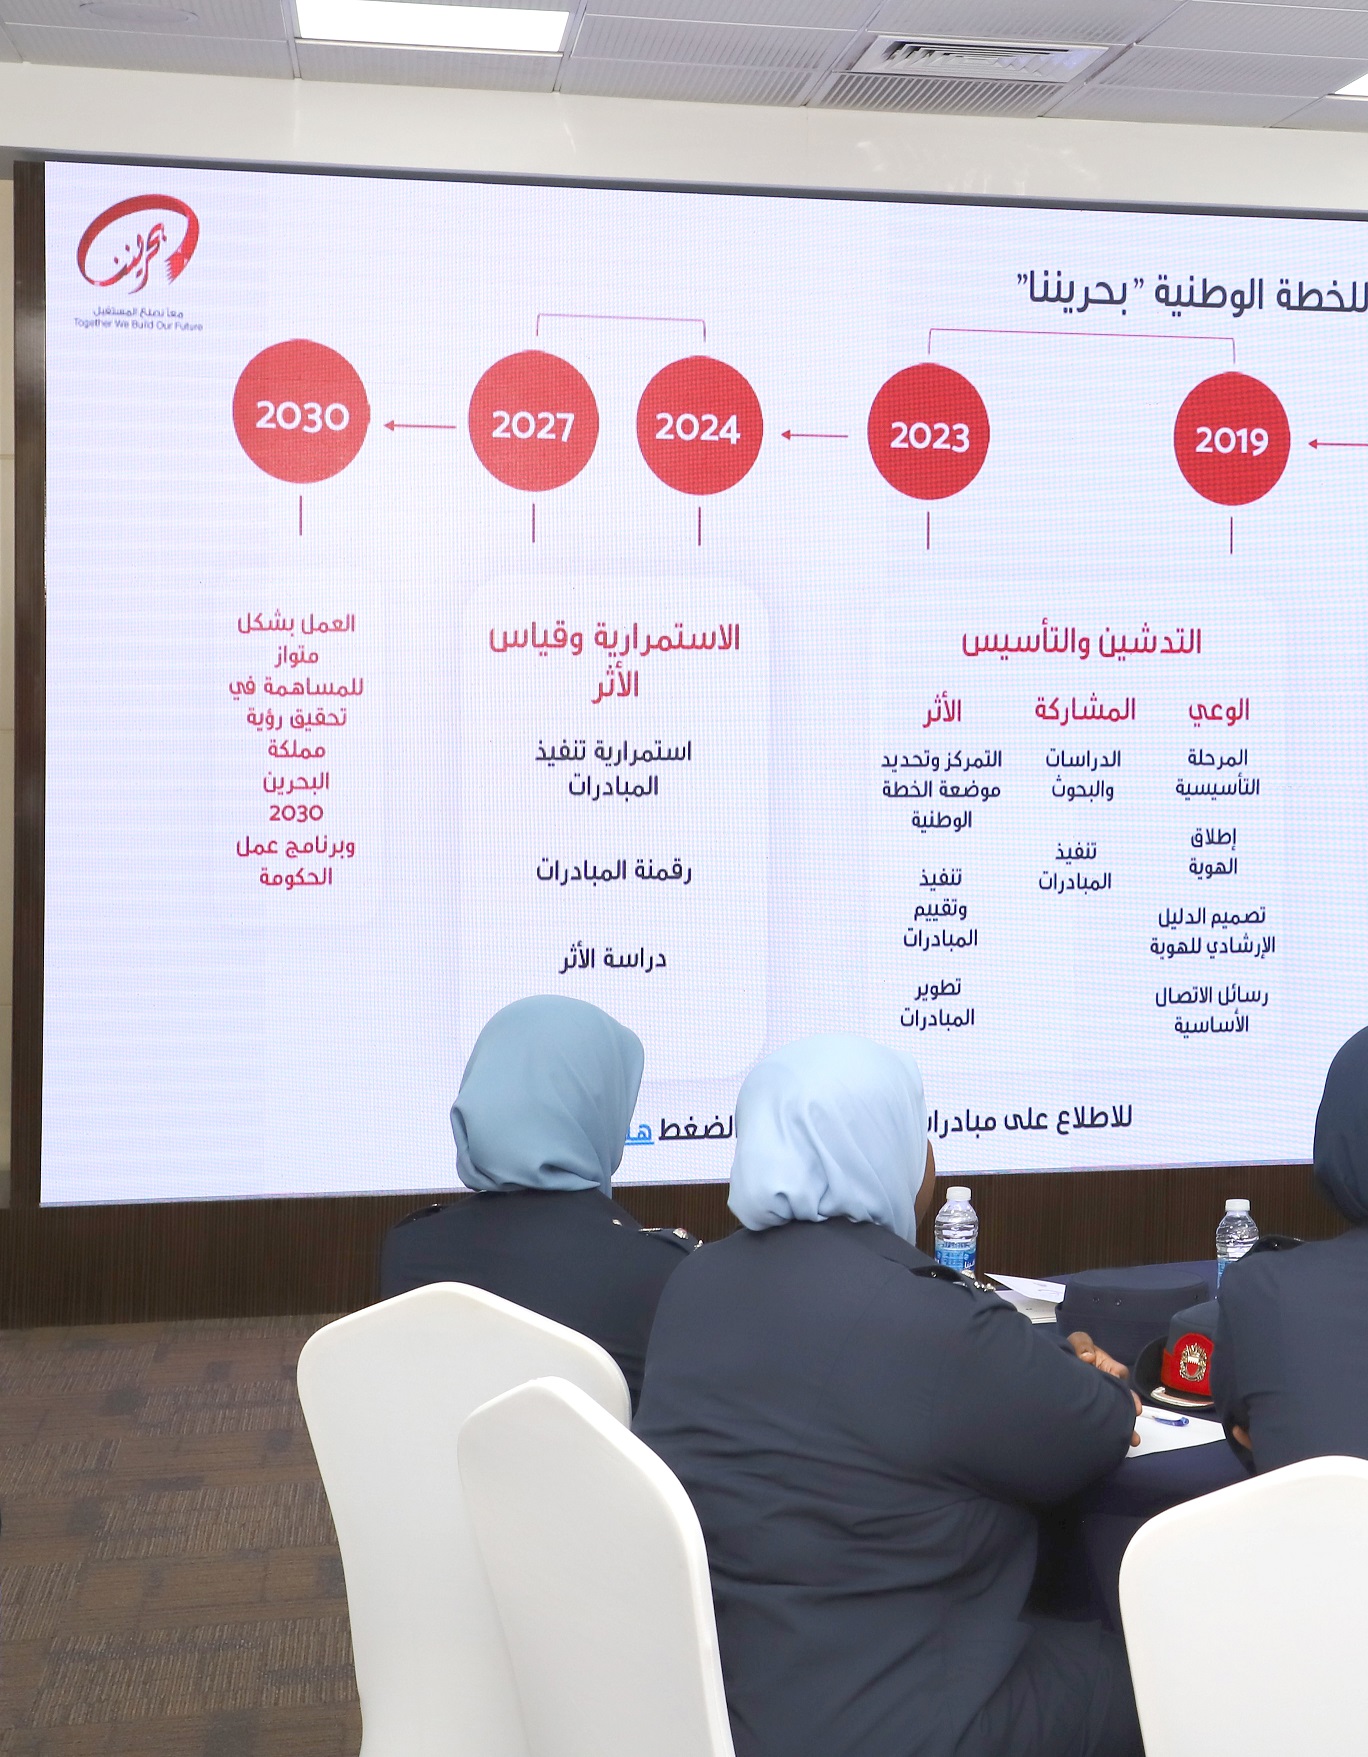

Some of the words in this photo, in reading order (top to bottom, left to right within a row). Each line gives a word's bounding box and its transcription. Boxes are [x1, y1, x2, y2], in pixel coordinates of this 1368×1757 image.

[1155, 274, 1263, 318] الوطنية
[1276, 278, 1368, 313] للخطة
[74, 317, 112, 329] Together
[132, 319, 154, 330] Build
[156, 321, 173, 330] Our
[175, 321, 203, 331] Future
[256, 401, 349, 433] 2030
[492, 411, 574, 442] 2027
[656, 413, 740, 444] 2024
[891, 422, 969, 452] 2023
[1196, 427, 1268, 456] 2019
[238, 608, 294, 637] بشكل
[302, 613, 355, 635] العمل
[489, 620, 583, 657] وقياس
[594, 622, 739, 658] الاستمرارية
[962, 617, 1090, 660] والتأسيس
[1099, 622, 1201, 661] التدشين
[274, 645, 318, 668] متواز
[229, 676, 256, 701] في
[264, 676, 363, 697] للمساهمة
[591, 660, 638, 704] الأثر
[247, 707, 282, 732] رؤية
[290, 708, 347, 732] تحقيق
[922, 690, 961, 728] الأثر
[1035, 692, 1135, 726] المشاركة
[1189, 697, 1249, 728] الوعي
[268, 739, 326, 760] مملكة
[535, 739, 585, 767] تنفيذ
[594, 740, 691, 767] استمرارية
[881, 750, 939, 773] وتحديد
[944, 749, 1002, 772] التمركز
[1046, 748, 1121, 772] الدراسات
[1188, 748, 1247, 770] المرحلة
[263, 771, 329, 795] البحرين
[569, 773, 658, 803] المبادرات
[883, 779, 932, 798] الخطة
[939, 780, 1000, 802] موضعة
[1052, 774, 1114, 803] والبحوث
[1176, 771, 1260, 801] التأسيسية
[269, 804, 323, 823] 2030
[911, 810, 972, 833] الوطنية
[237, 835, 278, 857] عمل
[285, 835, 355, 859] وبرنامج
[1191, 827, 1236, 851] إطلاق
[1055, 842, 1096, 865] تنفيذ
[260, 867, 332, 890] الحكومة
[537, 857, 626, 887] المبادرات
[635, 857, 691, 885] رقمنة
[919, 868, 962, 892] تنفيذ
[1189, 857, 1237, 880] الهوية
[1039, 871, 1111, 896] المبادرات
[914, 898, 967, 922] وتقييم
[1159, 907, 1206, 930] الدليل
[1211, 906, 1266, 929] تصميم
[904, 927, 977, 952] المبادرات
[1150, 937, 1202, 960] للهوية
[1206, 932, 1275, 959] الإرشادي
[558, 940, 595, 975] الأثر
[603, 947, 667, 973] دراسة
[914, 978, 961, 1002] تطوير
[1156, 986, 1212, 1007] الاتصال
[1218, 985, 1268, 1008] رسائل
[901, 1007, 974, 1031] المبادرات
[1175, 1008, 1248, 1039] الأساسية
[927, 1109, 996, 1141] مبادرا
[1004, 1107, 1048, 1131] على
[1056, 1104, 1132, 1135] للاطلاع
